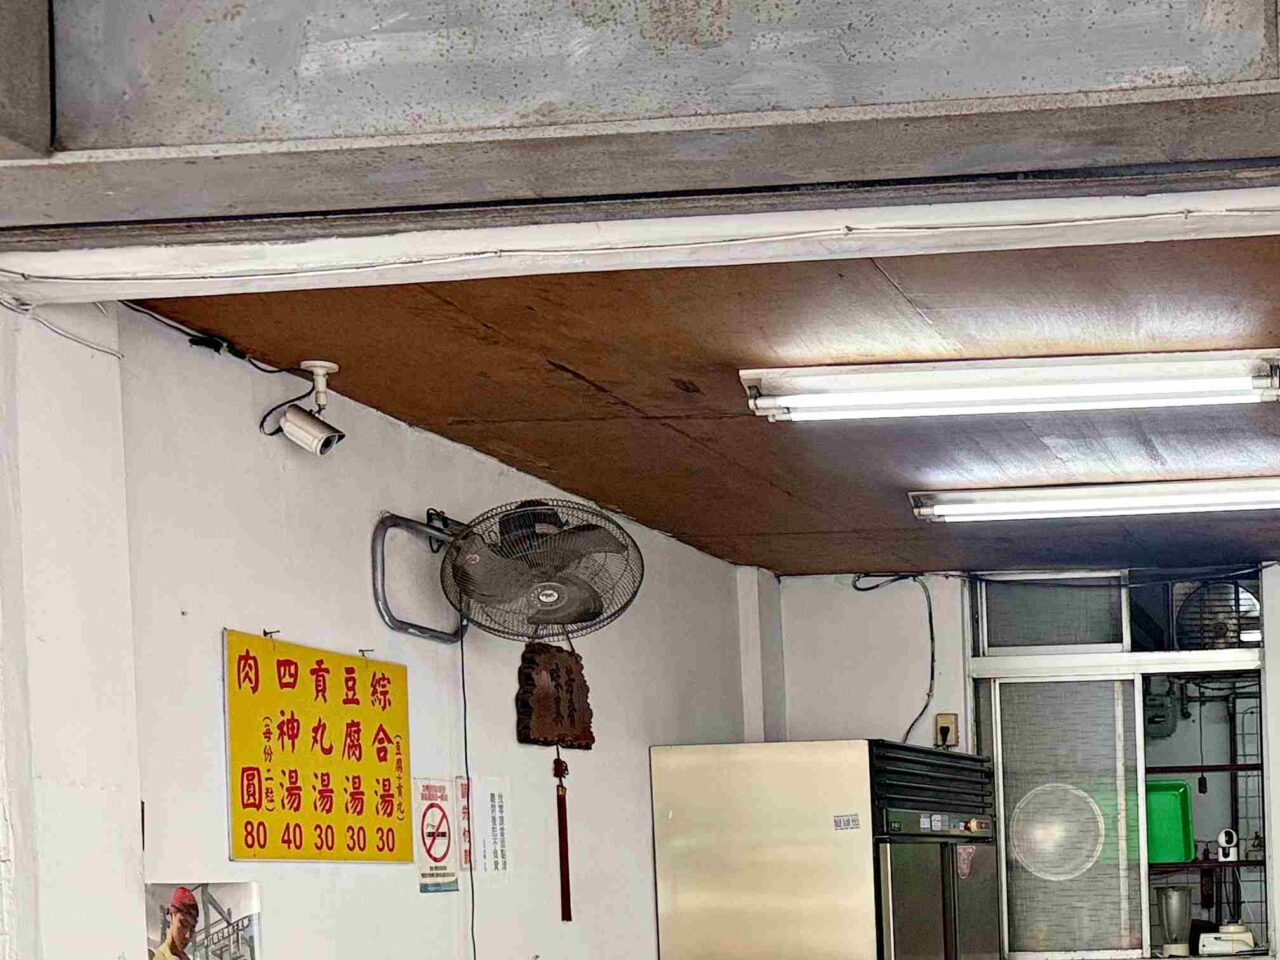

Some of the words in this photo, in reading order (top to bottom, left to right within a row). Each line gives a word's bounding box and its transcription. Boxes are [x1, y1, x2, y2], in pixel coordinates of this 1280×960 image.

[236, 649, 263, 811] 肉圓
[276, 658, 302, 813] 四神湯
[310, 659, 334, 815] 貢丸湯
[341, 666, 365, 817] 豆腐湯
[370, 672, 395, 818] 綜合湯
[244, 820, 267, 849] 80
[281, 822, 303, 850] 40
[314, 824, 334, 851] 30
[346, 825, 366, 852] 30
[376, 826, 395, 852] 30
